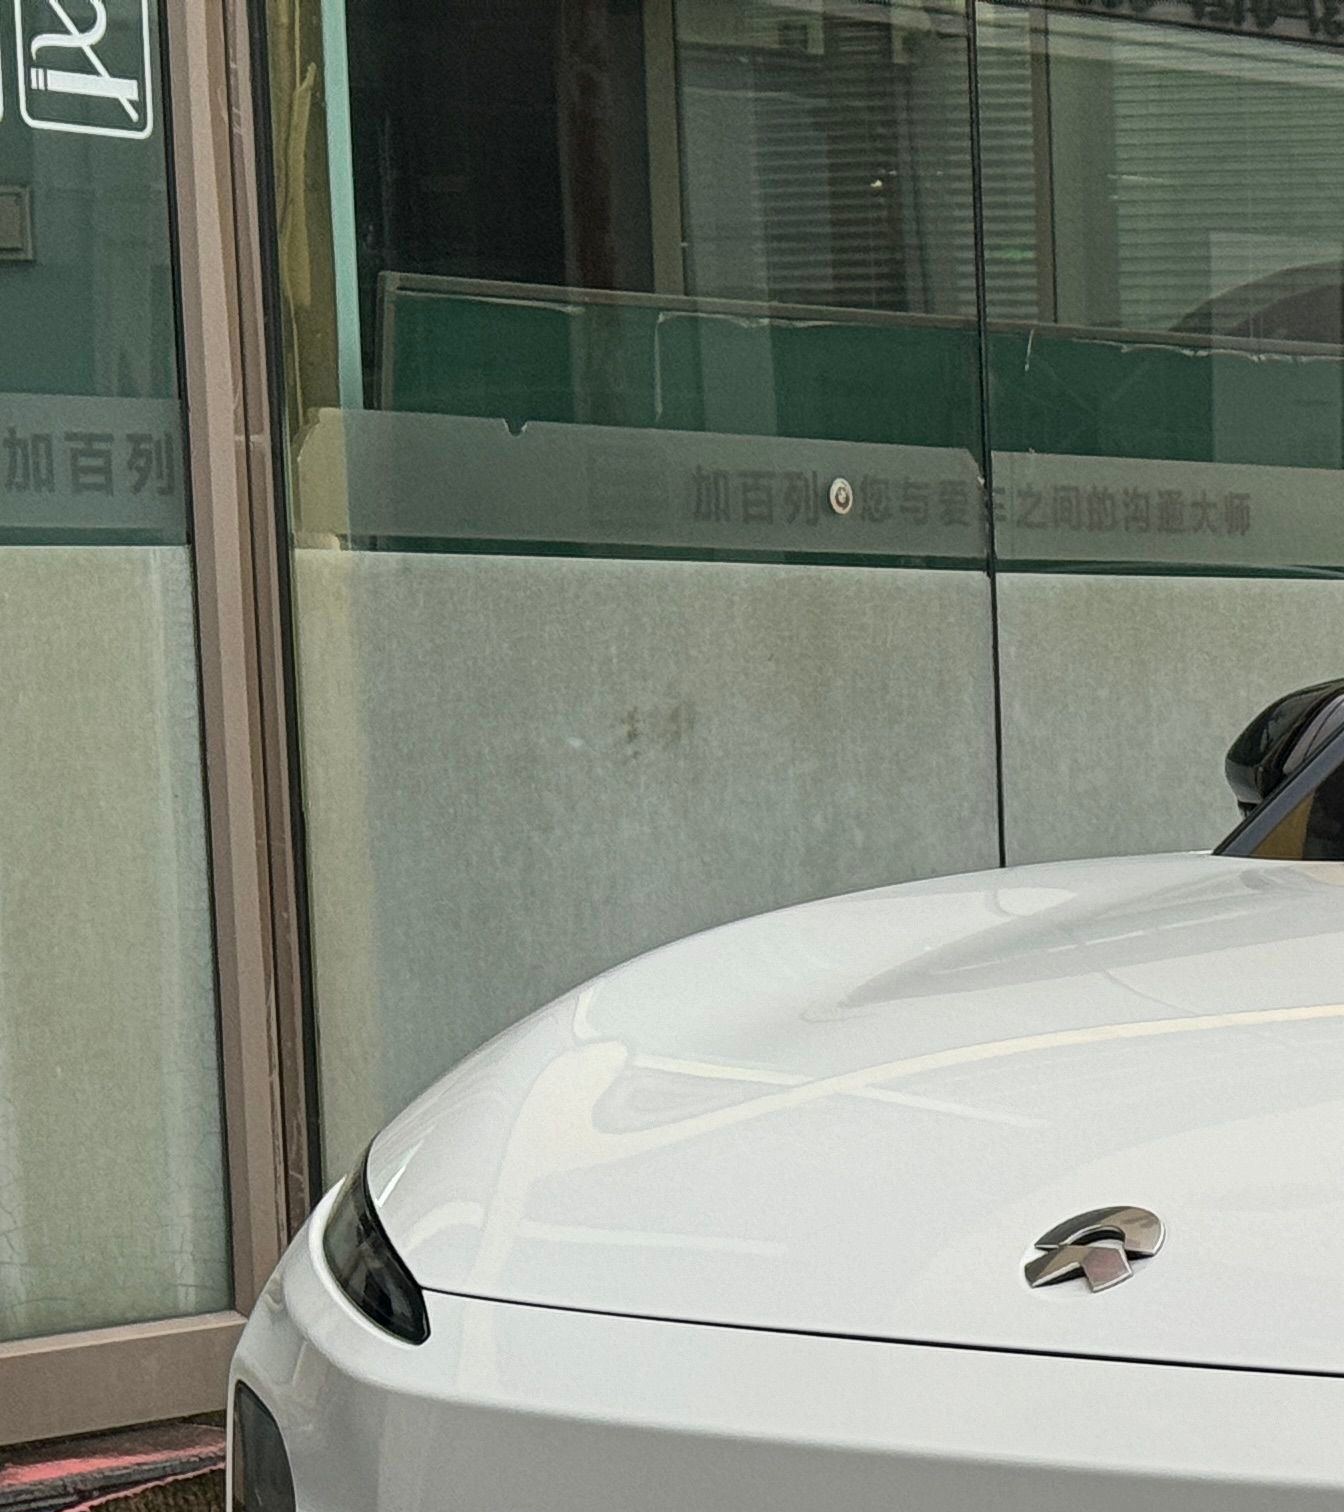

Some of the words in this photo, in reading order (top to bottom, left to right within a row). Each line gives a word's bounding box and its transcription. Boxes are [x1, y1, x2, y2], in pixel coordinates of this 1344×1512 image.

[3, 426, 175, 496] 加百列
[690, 464, 820, 527] 加百列
